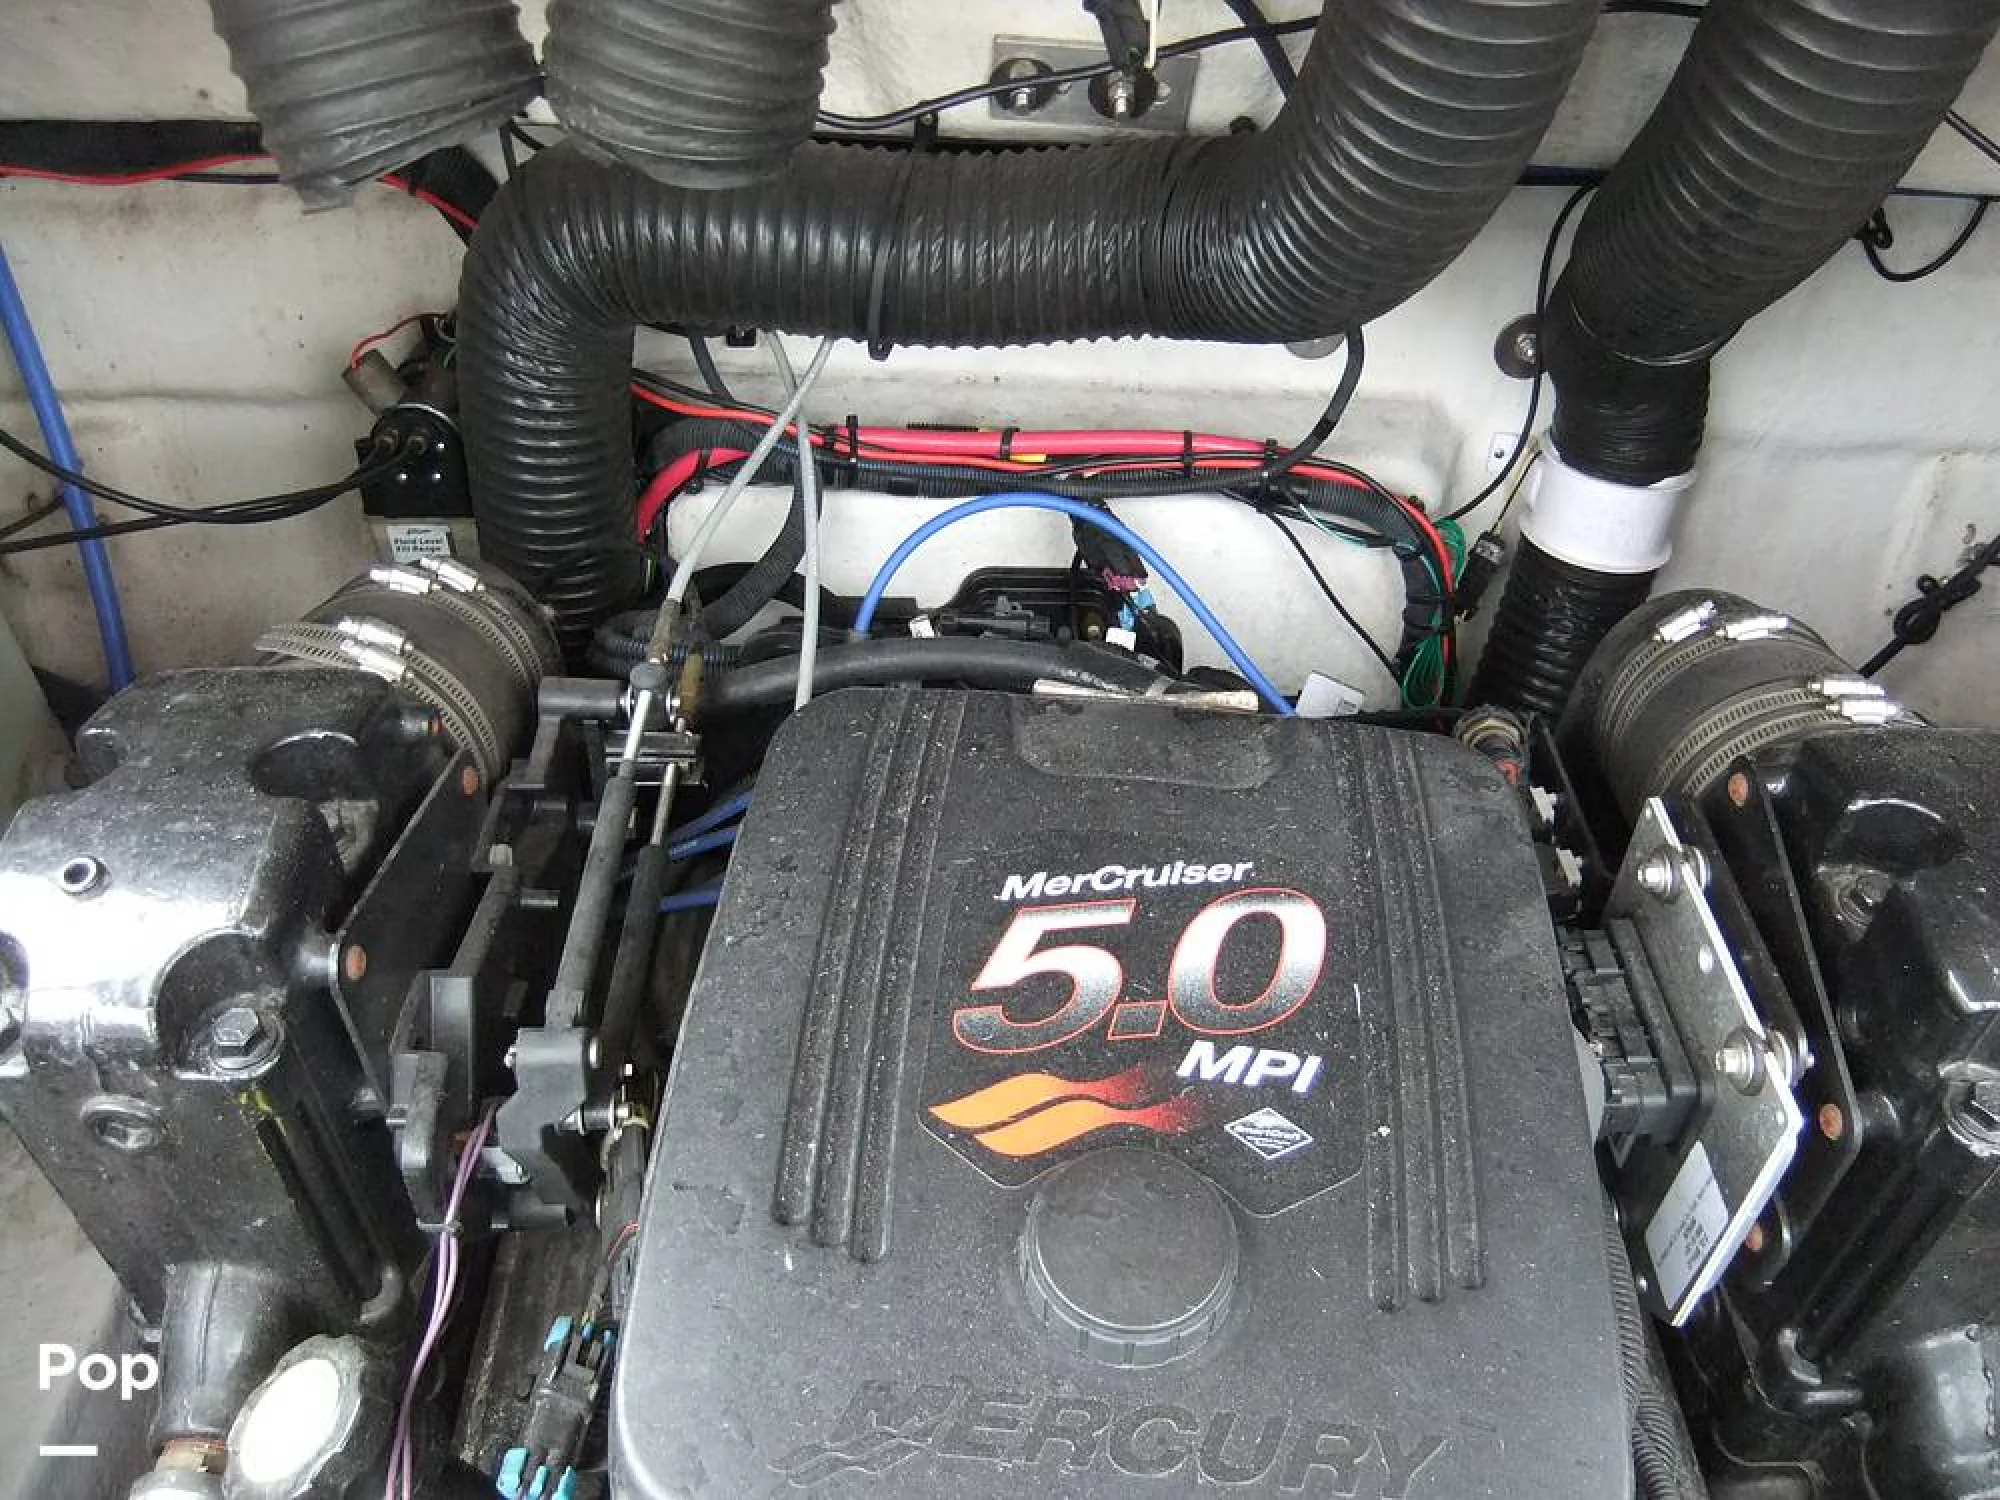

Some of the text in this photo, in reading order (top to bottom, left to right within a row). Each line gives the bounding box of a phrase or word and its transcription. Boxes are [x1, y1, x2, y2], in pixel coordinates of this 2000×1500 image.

[393, 537, 443, 545] Fluid Level
[419, 546, 442, 554] Range
[997, 859, 1254, 900] MerCruiser
[952, 886, 1327, 1055] 5.0
[1175, 1039, 1324, 1095] MPI
[826, 1376, 1449, 1499] MERCURY
